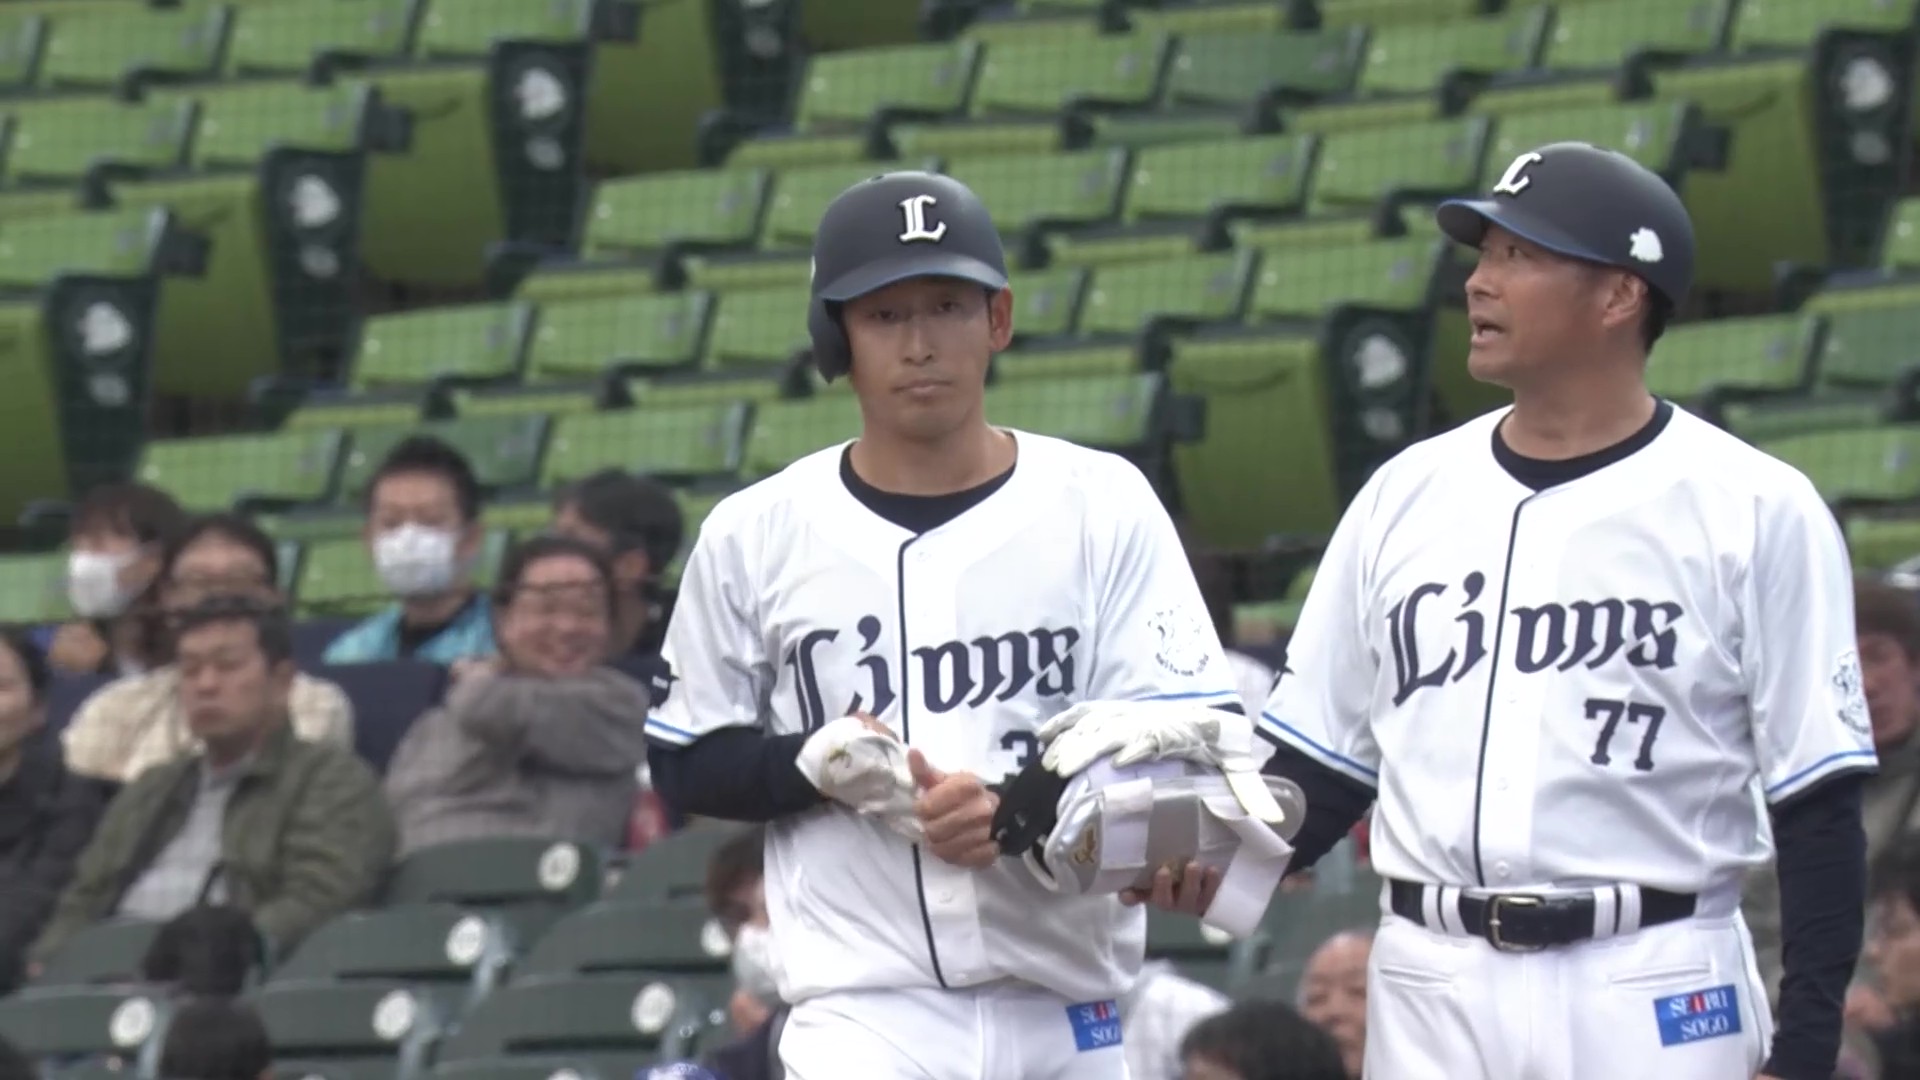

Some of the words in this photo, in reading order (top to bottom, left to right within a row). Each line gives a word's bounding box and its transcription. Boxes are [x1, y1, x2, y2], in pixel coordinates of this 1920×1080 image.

[1493, 152, 1542, 195] L
[899, 194, 947, 242] L
[1387, 571, 1684, 707] Lions
[1584, 698, 1666, 771] 77
